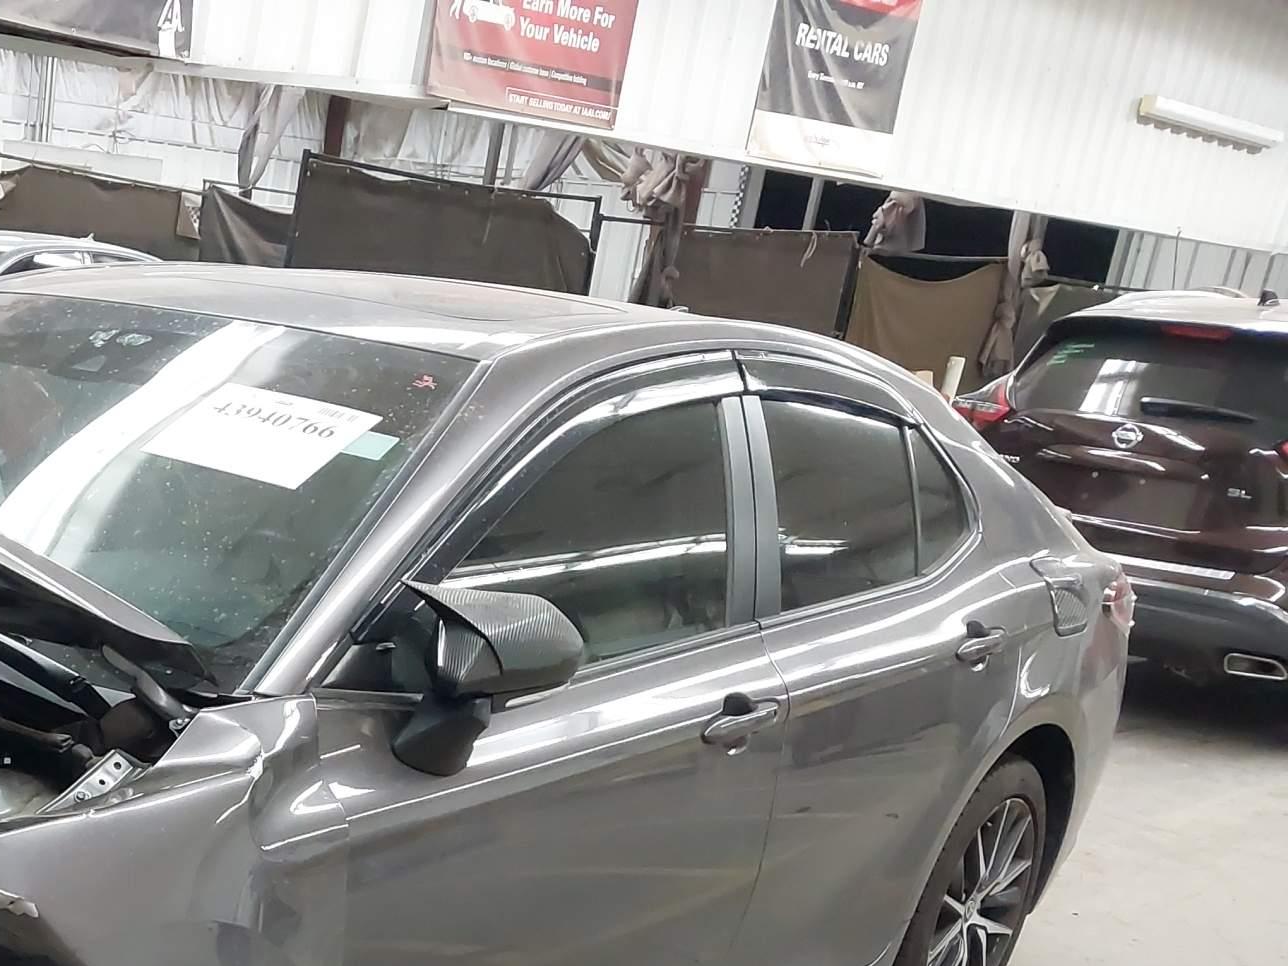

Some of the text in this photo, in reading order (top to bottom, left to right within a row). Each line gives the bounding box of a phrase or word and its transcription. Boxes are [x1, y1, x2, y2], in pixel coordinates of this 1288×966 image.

[556, 0, 591, 23] More
[592, 6, 615, 28] For
[519, 16, 600, 53] Your Vehicle
[795, 22, 889, 66] RENTAL CARS
[213, 401, 336, 439] 43940766
